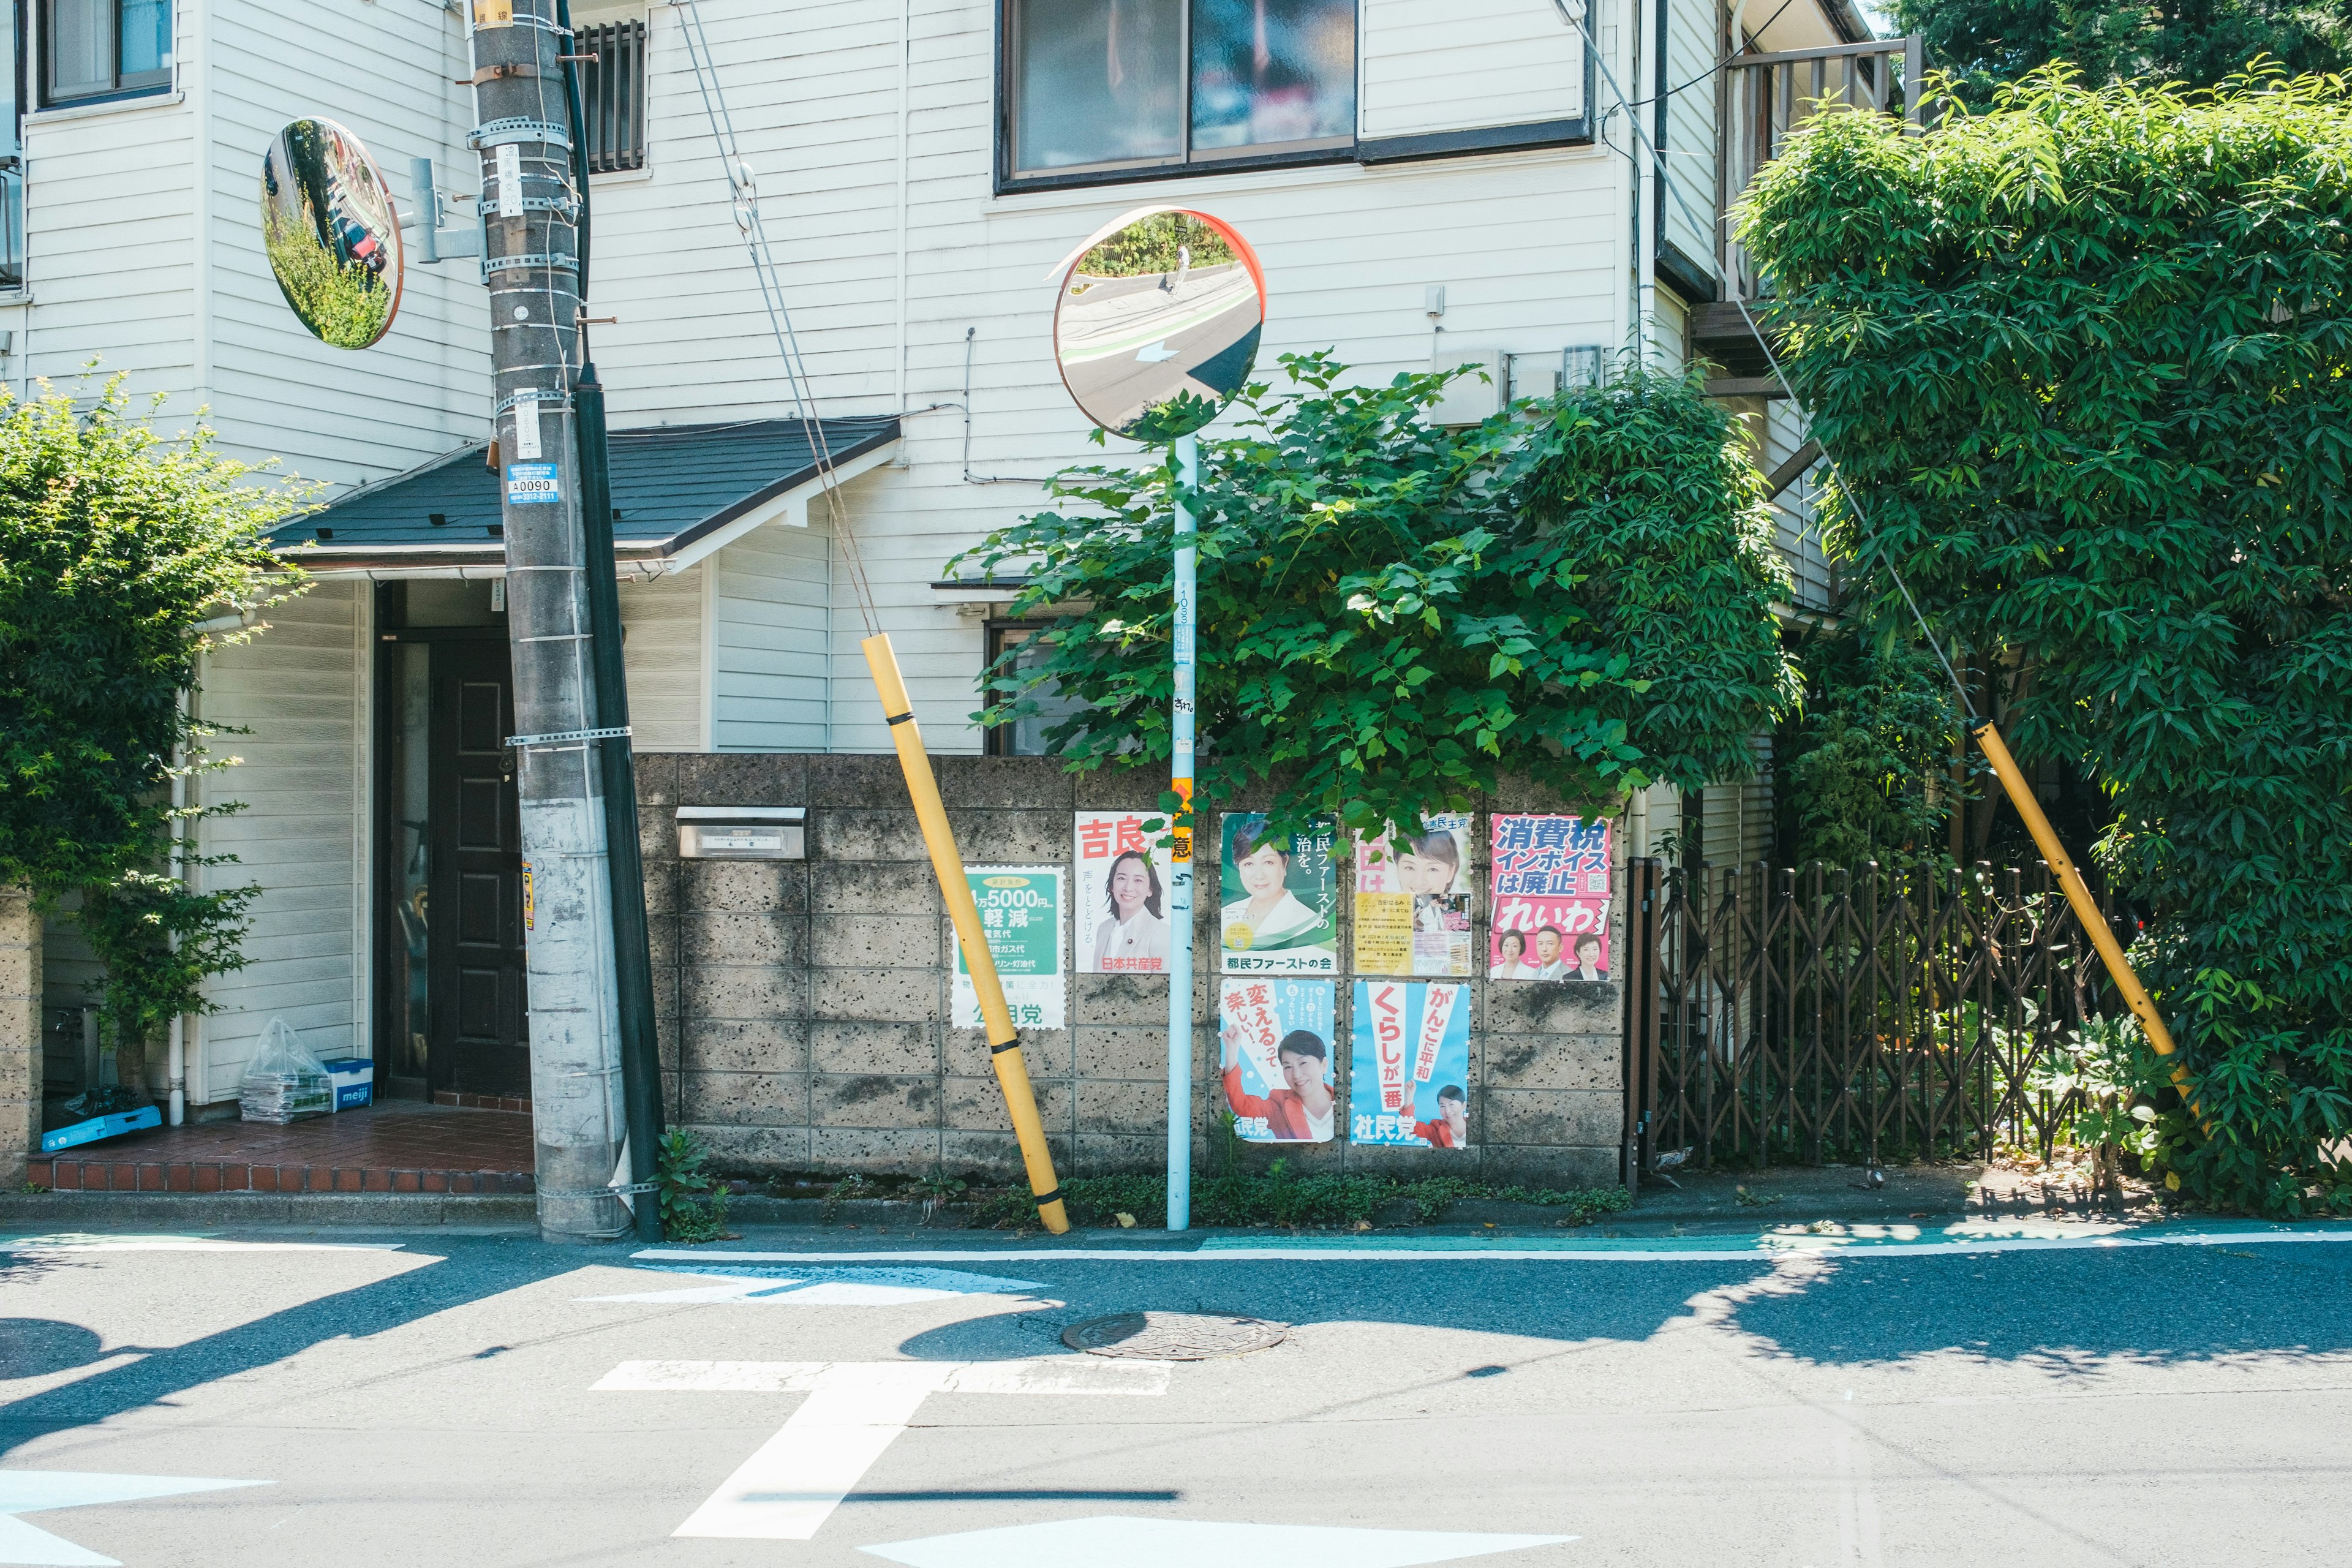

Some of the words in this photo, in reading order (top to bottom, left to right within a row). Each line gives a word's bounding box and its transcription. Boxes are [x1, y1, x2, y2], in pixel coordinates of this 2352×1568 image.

[514, 480, 550, 491] A0090
[1495, 816, 1607, 851] 消費税
[1296, 832, 1312, 875] 治を。
[1495, 850, 1608, 873] インボイス
[1496, 870, 1578, 895] は廃止
[984, 908, 1028, 928] 軽減
[1082, 870, 1095, 949] 声をとどける。
[1498, 897, 1595, 933] れいわ
[984, 929, 1011, 938] 電気代
[1102, 957, 1163, 970] 日本共産党
[1227, 957, 1332, 970] 都民ファーストの会
[1287, 985, 1297, 1026] もったいない
[1246, 984, 1277, 1068] 変えるって
[1416, 987, 1453, 1080] がんこに平和
[1374, 986, 1403, 1109] くらしが一番
[343, 1087, 368, 1102] meiji
[1354, 1114, 1417, 1141] 社民党
